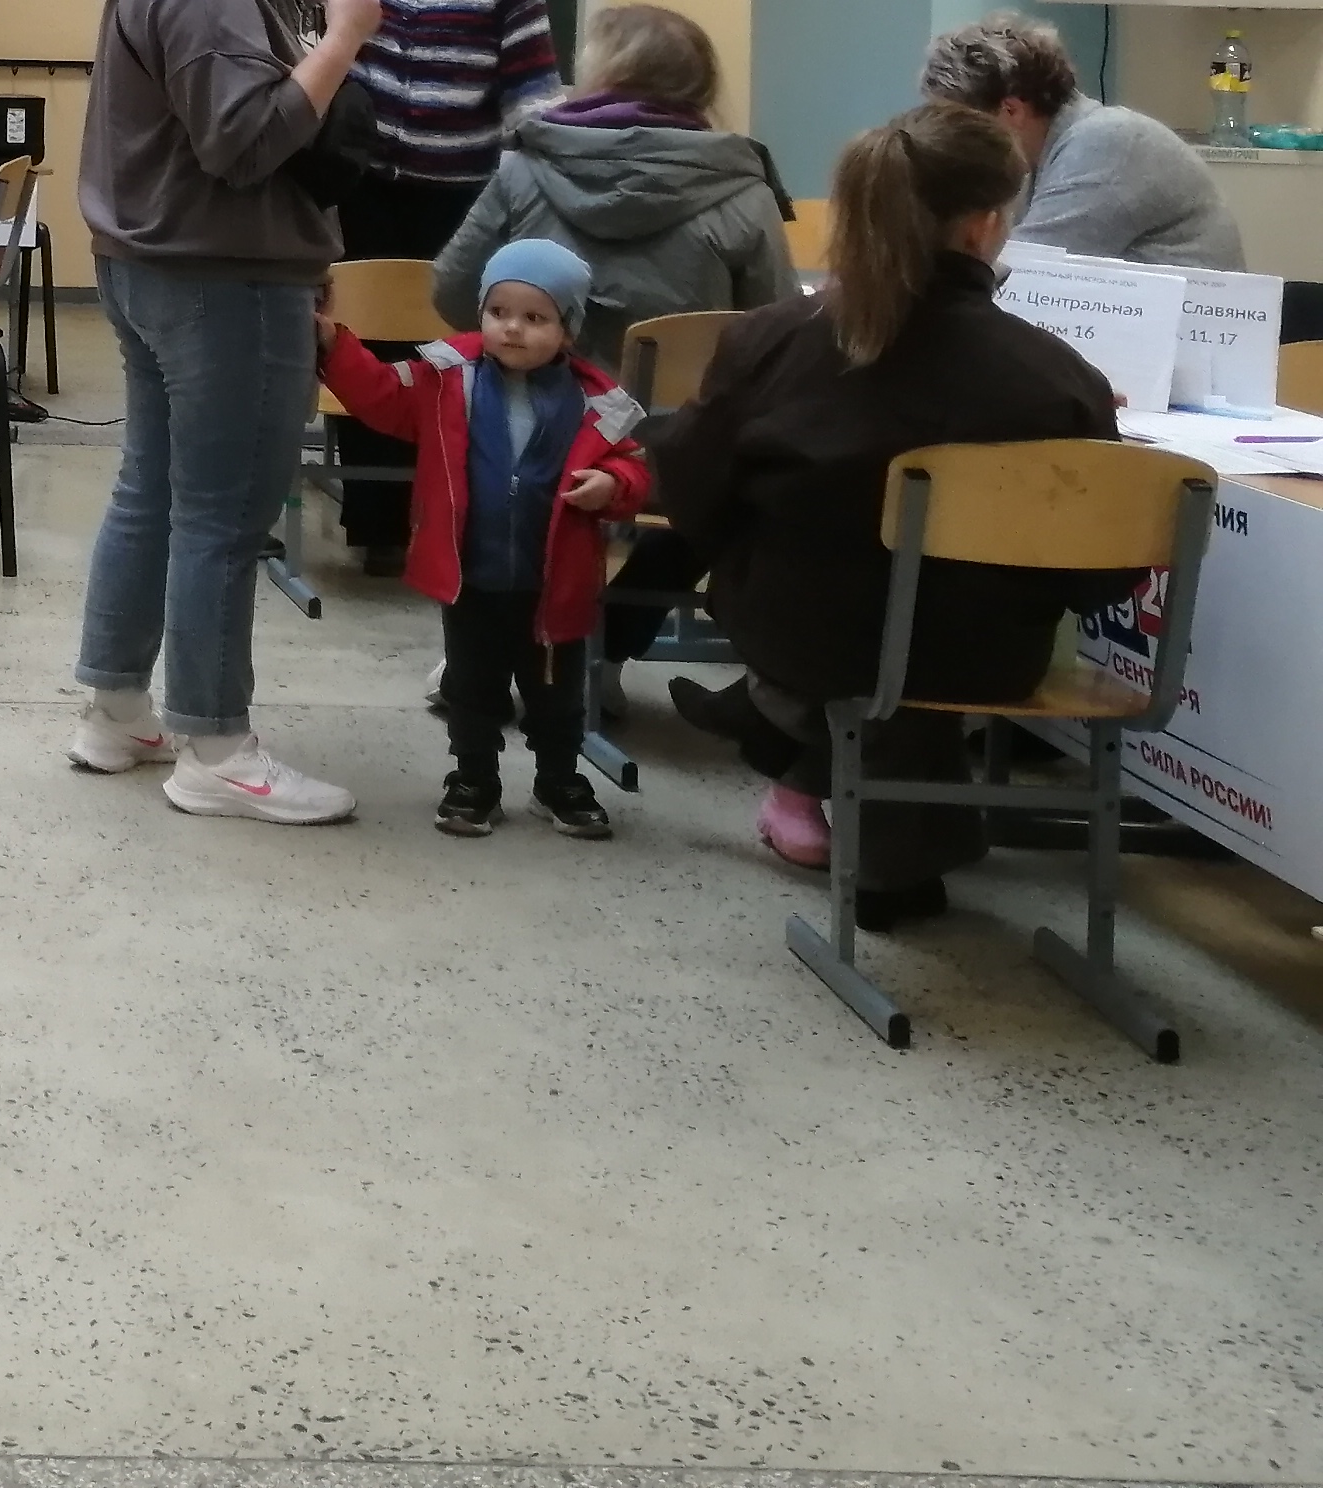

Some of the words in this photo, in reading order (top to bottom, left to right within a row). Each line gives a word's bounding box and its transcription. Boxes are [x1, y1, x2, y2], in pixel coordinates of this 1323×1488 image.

[1027, 290, 1143, 318] Центральная
[1181, 300, 1267, 323] Славянка
[1074, 325, 1095, 340] 16
[1219, 333, 1238, 346] 17
[1140, 740, 1187, 785] СИЛА
[1190, 765, 1273, 831] РОССИИ!
